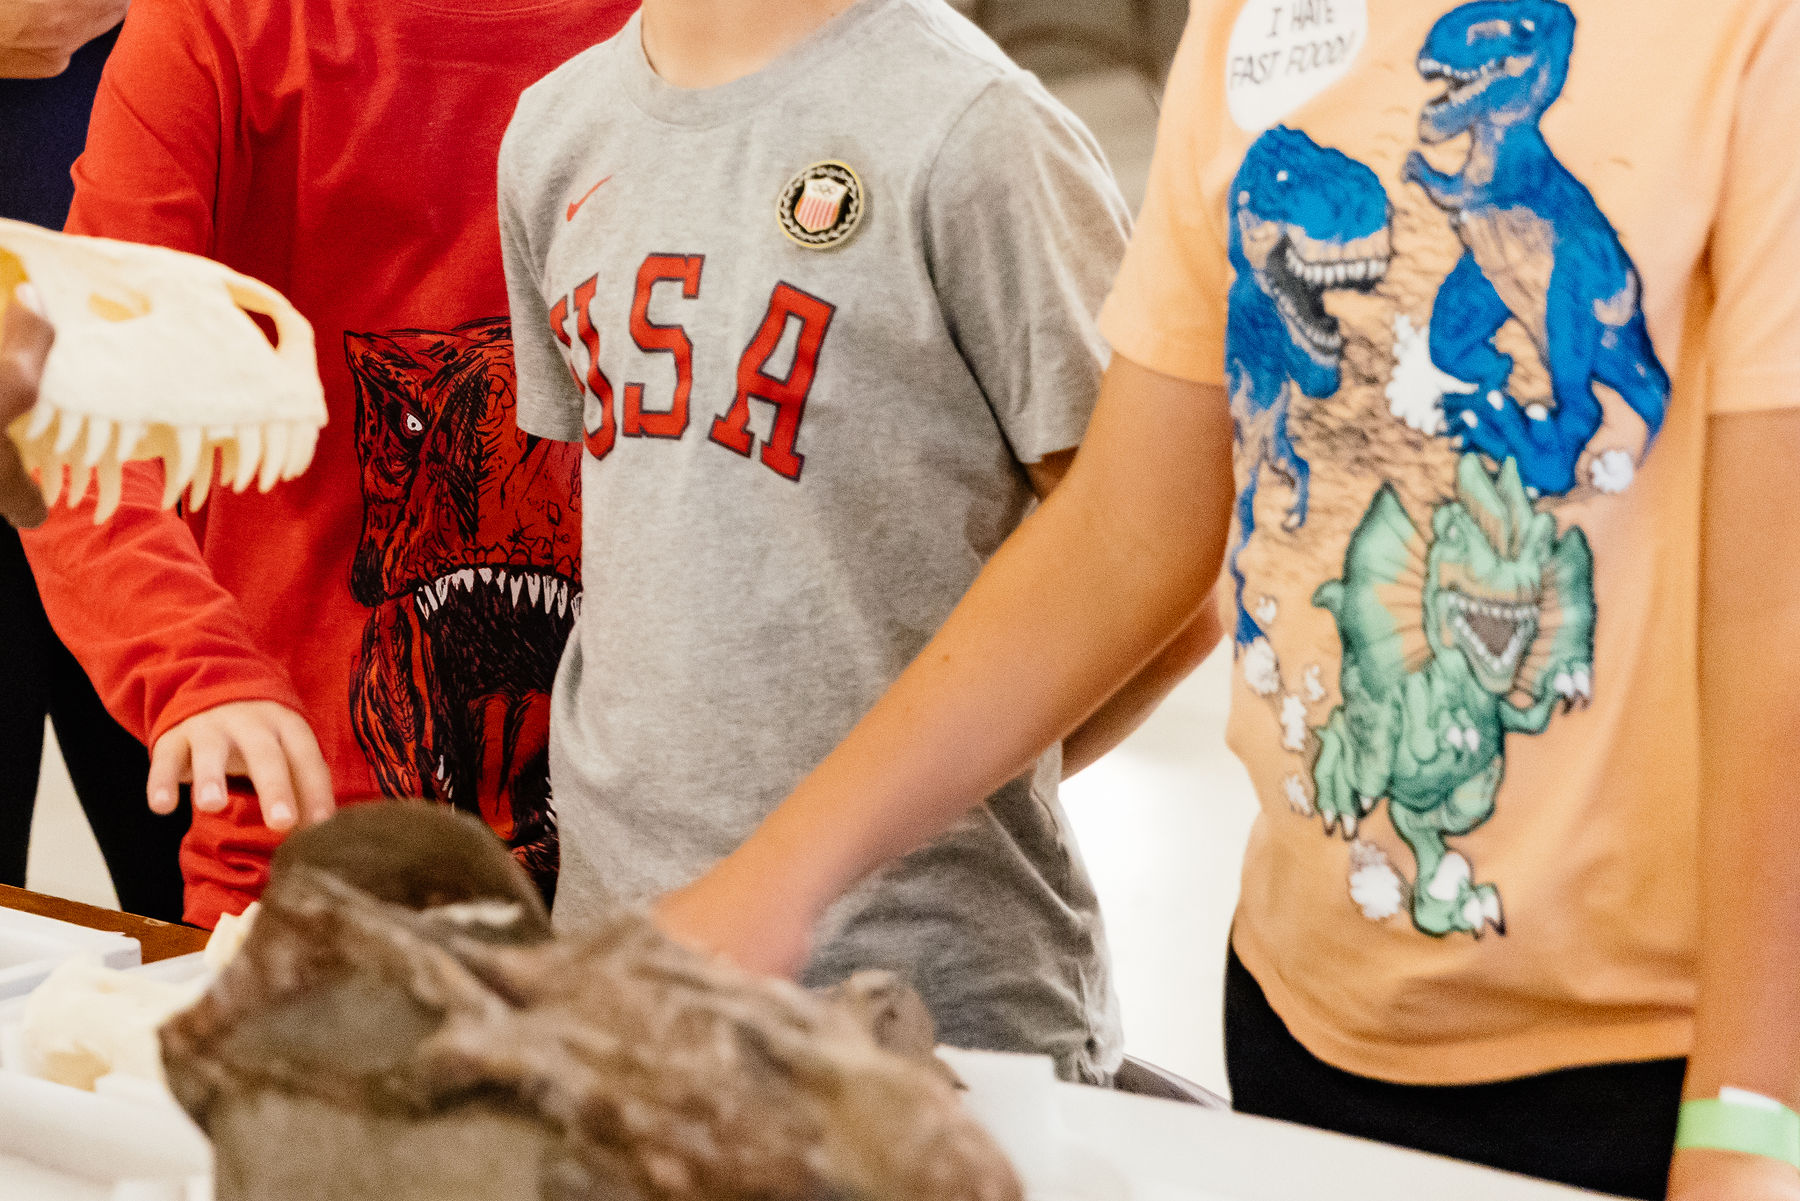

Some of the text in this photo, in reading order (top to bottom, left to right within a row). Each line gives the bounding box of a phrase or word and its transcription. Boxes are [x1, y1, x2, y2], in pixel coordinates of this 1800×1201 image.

[1266, 7, 1282, 38] I
[1229, 50, 1280, 90] FAST
[550, 252, 836, 482] USA
